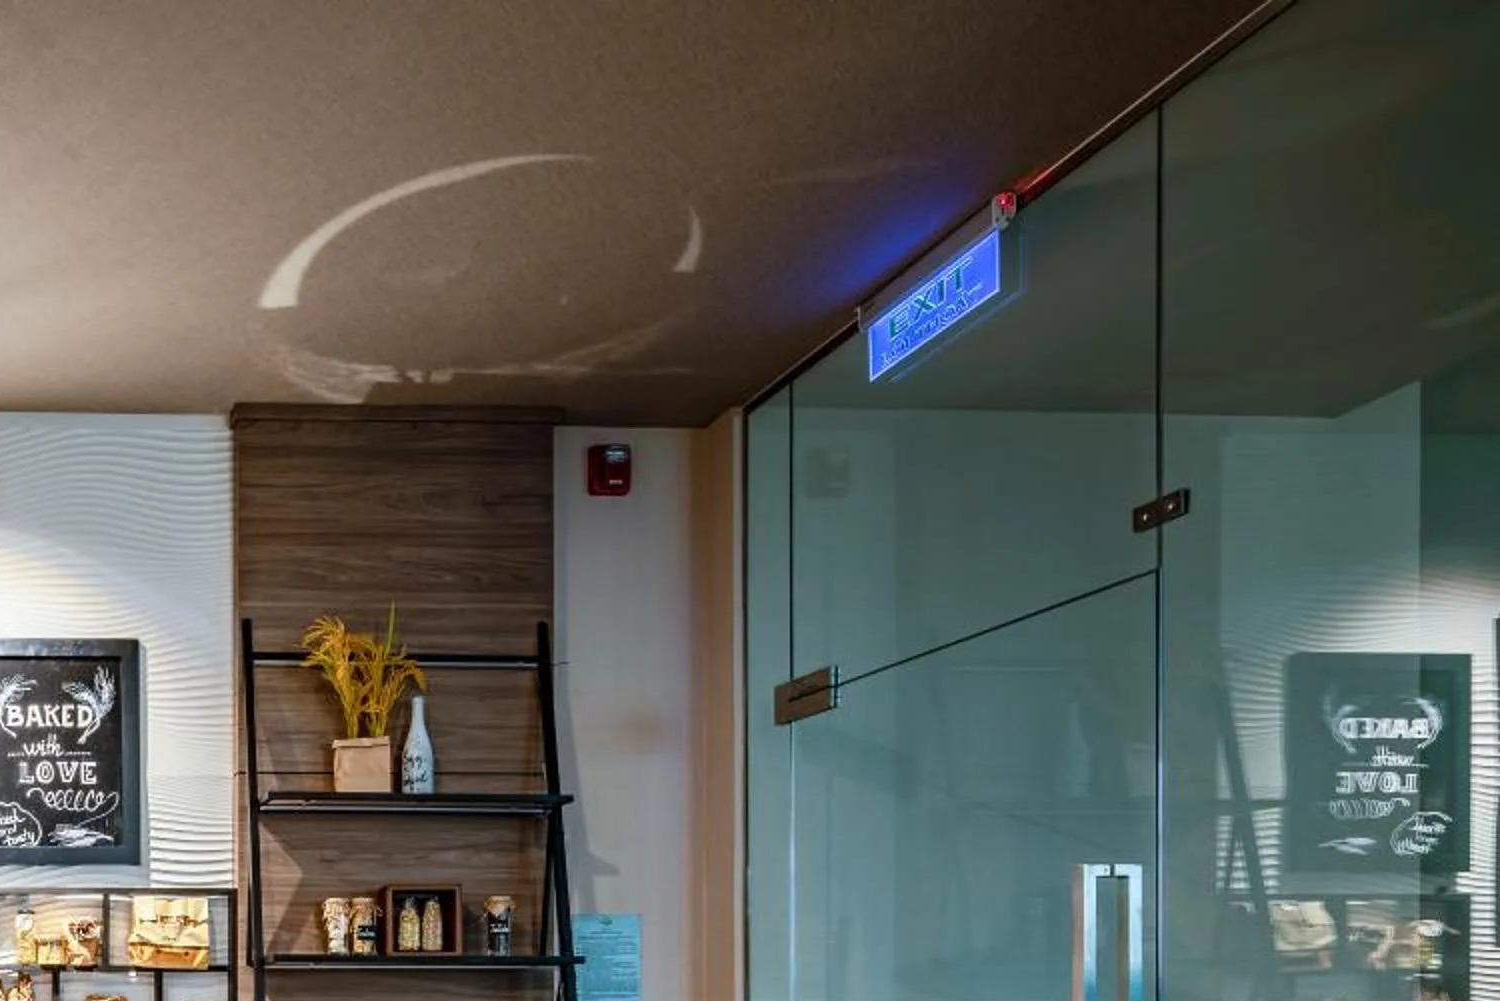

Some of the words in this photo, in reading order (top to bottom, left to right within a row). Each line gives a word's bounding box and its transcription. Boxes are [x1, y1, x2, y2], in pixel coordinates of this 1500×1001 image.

[889, 256, 974, 342] EXIT
[6, 703, 94, 728] BAKED
[22, 733, 64, 757] with
[17, 761, 97, 785] LOVE
